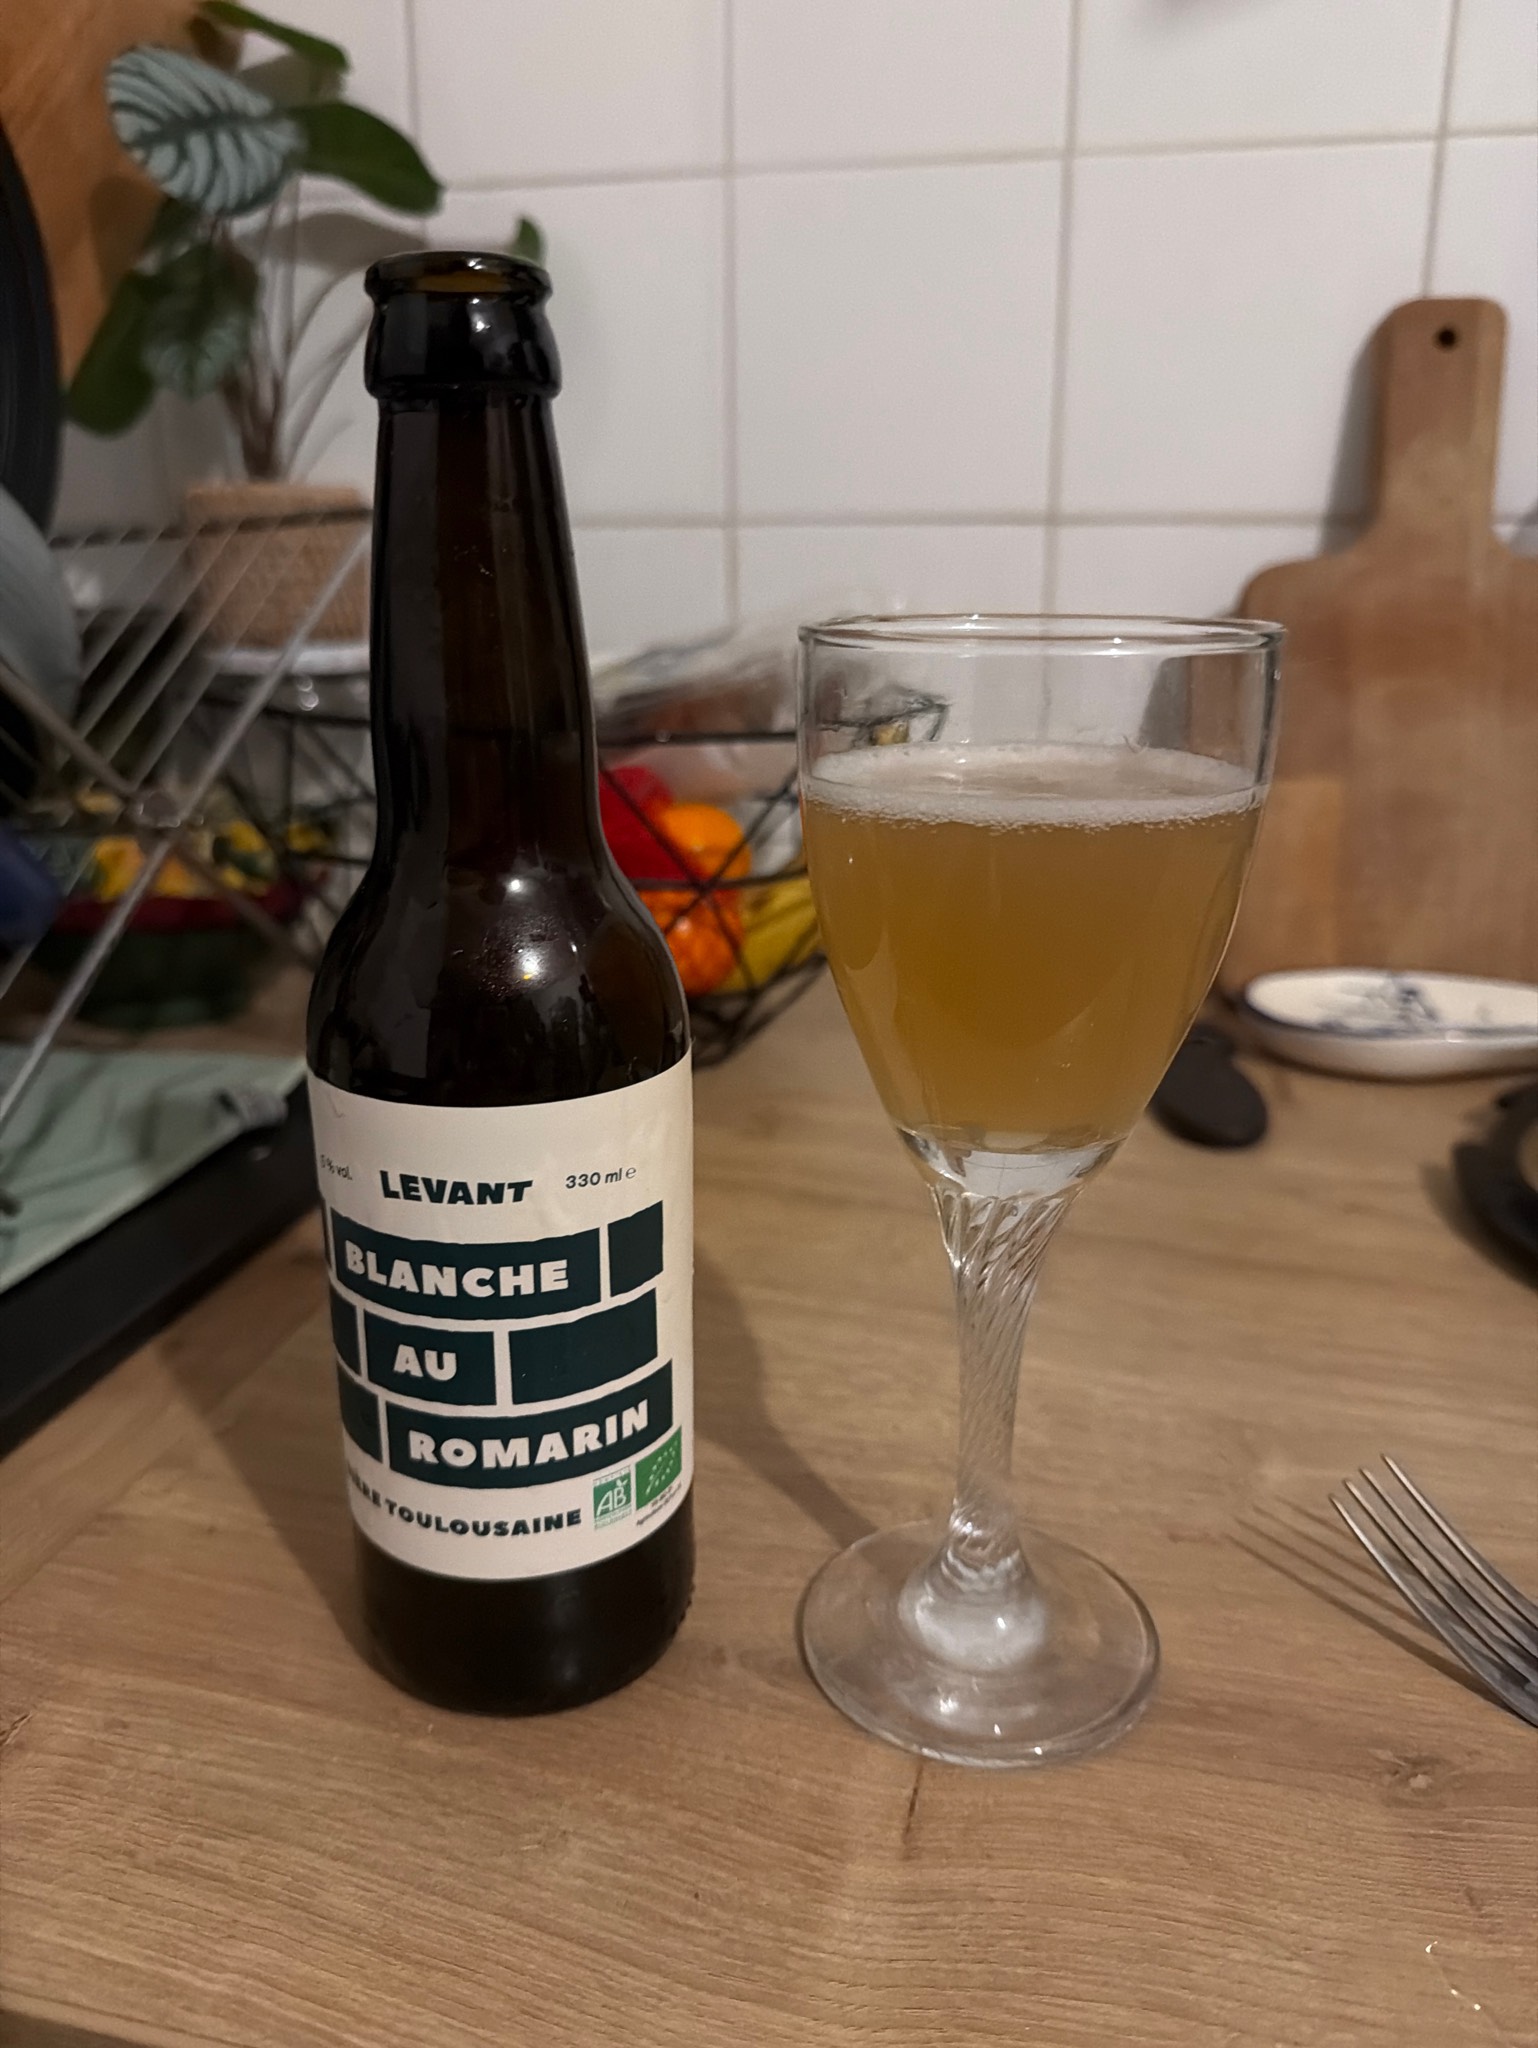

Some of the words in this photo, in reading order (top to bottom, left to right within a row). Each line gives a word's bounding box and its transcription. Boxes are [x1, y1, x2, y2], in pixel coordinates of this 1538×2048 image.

[380, 1170, 533, 1205] LEVANT
[565, 1172, 601, 1189] 330
[604, 1167, 623, 1184] ml
[345, 1240, 569, 1298] BLANCHE
[393, 1345, 458, 1382] AU
[408, 1398, 649, 1470] ROMARIN
[385, 1498, 582, 1537] TOULOUSAINE
[596, 1486, 627, 1517] AB
